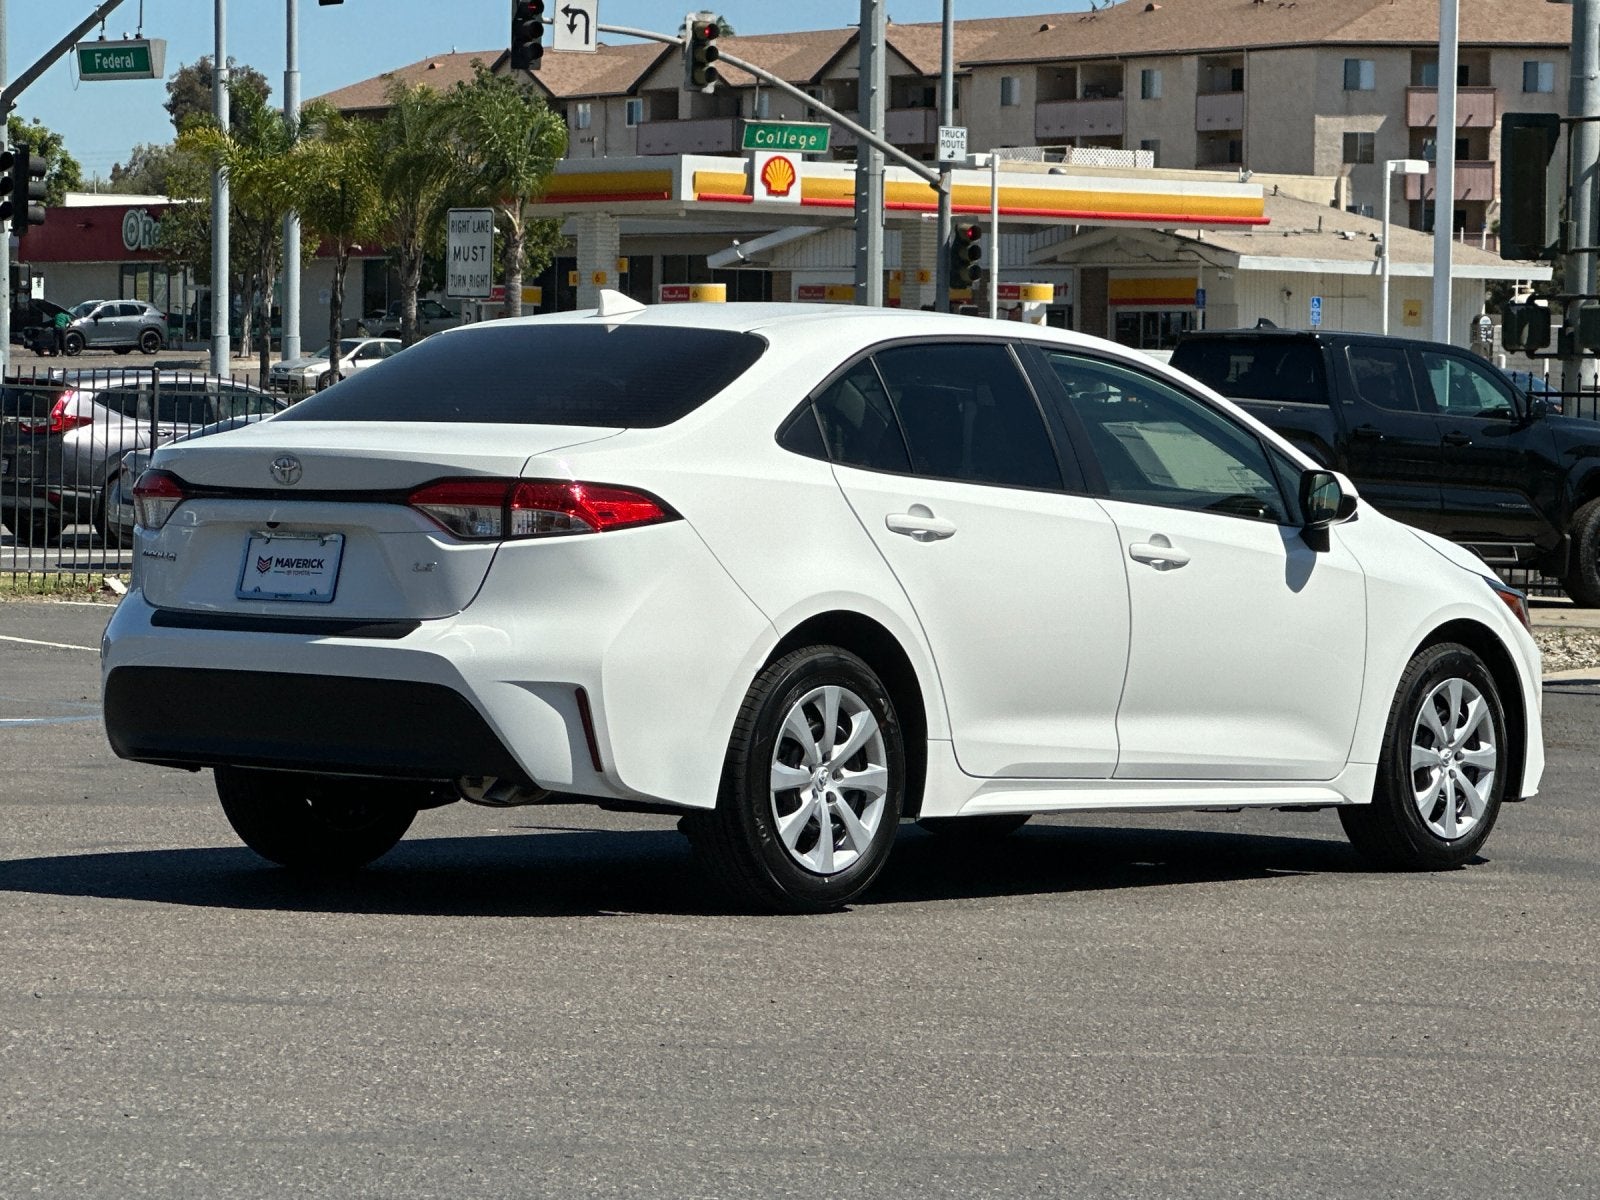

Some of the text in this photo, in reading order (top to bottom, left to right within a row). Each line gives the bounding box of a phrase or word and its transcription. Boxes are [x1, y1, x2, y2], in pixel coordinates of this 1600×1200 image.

[94, 52, 135, 69] Federal
[755, 129, 817, 149] College
[940, 130, 965, 138] TRUCK
[941, 140, 965, 149] ROUTE
[450, 219, 489, 233] RIGHT LANE
[453, 246, 486, 262] MUST
[450, 274, 488, 288] TURN RIGHT
[275, 557, 325, 569] MAVERICK
